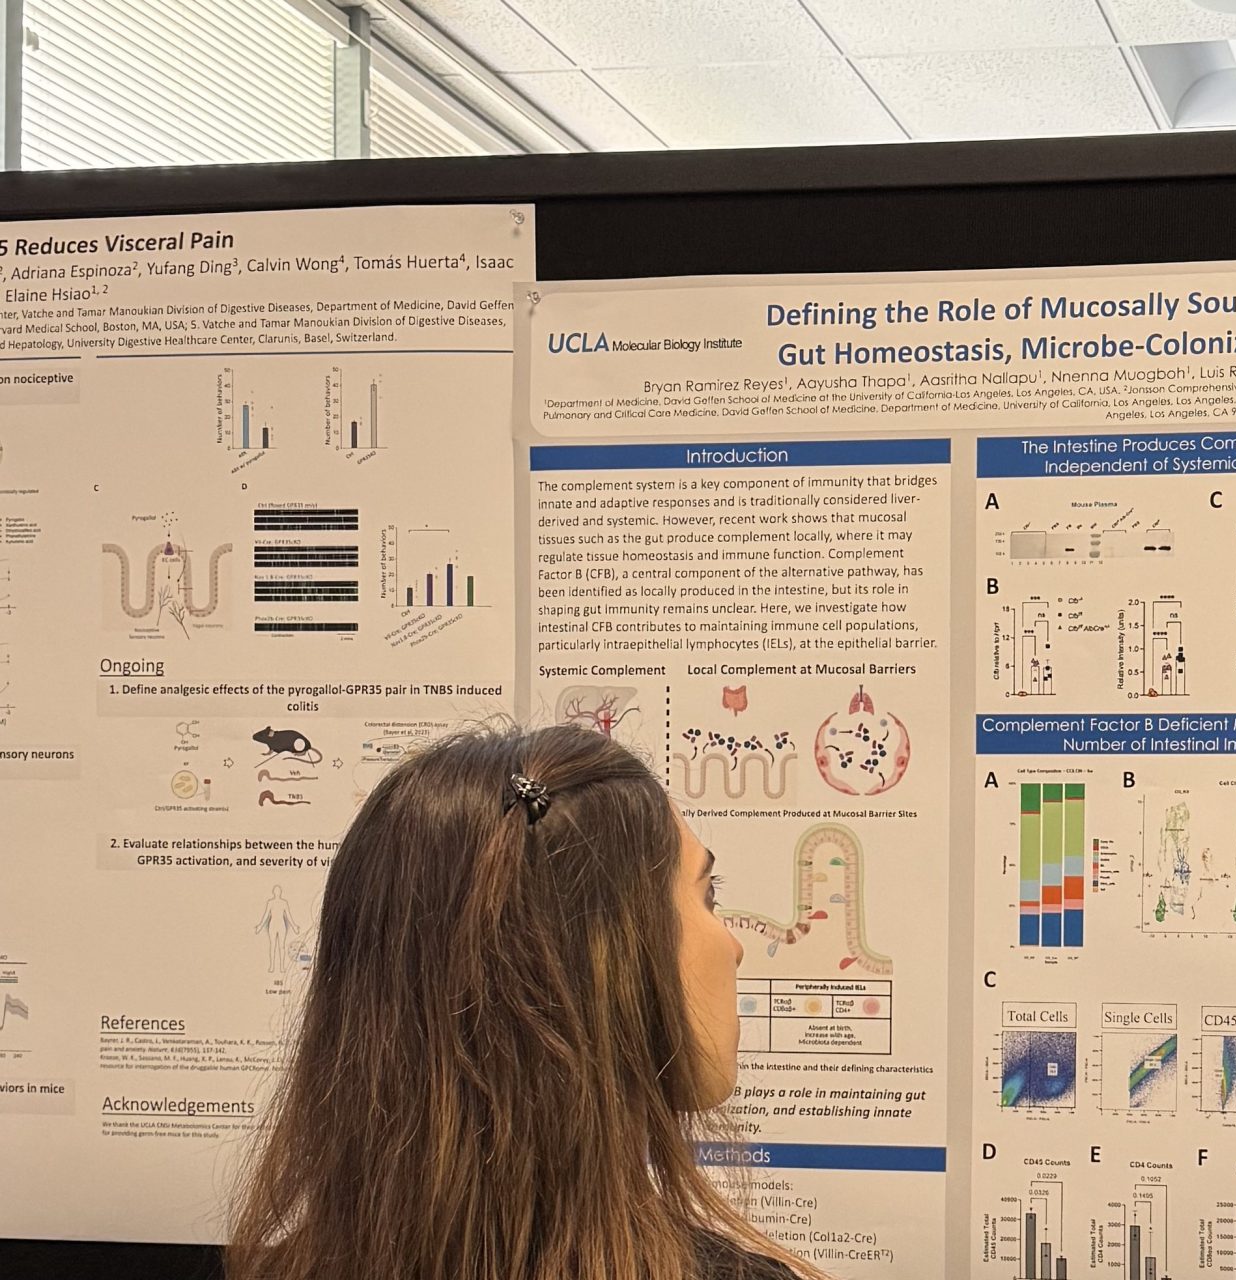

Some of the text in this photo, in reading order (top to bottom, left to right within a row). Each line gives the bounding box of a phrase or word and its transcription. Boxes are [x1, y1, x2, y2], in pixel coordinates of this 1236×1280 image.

[15, 230, 234, 256] Reduces Visceral Pain
[10, 265, 66, 280] Adriana
[246, 257, 293, 274] Calvin
[767, 301, 878, 330] Defining
[884, 299, 929, 324] the
[938, 297, 996, 322] Role
[1004, 296, 1034, 320] of
[1041, 291, 1180, 319] Mucosally
[548, 332, 743, 354] UCLA Molecular Biology Institute
[778, 343, 826, 367] Gut
[835, 337, 1012, 365] Homeostasis,
[13, 372, 74, 386] nociceptive
[644, 378, 739, 396] Bryan Ramirez
[1021, 440, 1049, 454] The
[1053, 438, 1118, 454] Intestine
[1122, 437, 1196, 452] Produces
[687, 447, 789, 464] Introduction
[1045, 457, 1148, 474] Independent
[1152, 456, 1169, 472] of
[537, 474, 938, 494] The complement system is a key component of immunity that bridges
[984, 492, 1000, 510] A
[1210, 491, 1223, 509] C
[987, 577, 999, 595] B
[99, 657, 165, 676] Ongoing
[539, 664, 666, 679] Systemic Complement
[687, 663, 916, 677] Local Complement at Mucosal Barriers
[109, 683, 502, 697] 1. Define analgesic effects of the pyrogallol-GPR35 pair in TNBS induced
[286, 701, 319, 712] colitis
[982, 717, 1085, 735] Complement
[1090, 717, 1141, 732] Factor
[1144, 717, 1154, 732] B
[1158, 717, 1229, 732] Deficient
[1063, 737, 1127, 752] Number
[1130, 737, 1147, 751] of
[1151, 736, 1219, 752] Intestinal
[32, 749, 75, 760] neurons
[984, 771, 999, 788] A
[110, 838, 315, 852] 2. Evaluate relationships between the
[983, 970, 997, 988] C
[100, 1014, 185, 1033] References
[1007, 1010, 1069, 1023] Total Cells
[1104, 1010, 1174, 1028] Single Cells
[27, 1082, 65, 1094] in mice
[743, 1085, 926, 1103] plays a role in maintaining gut
[102, 1097, 255, 1116] Acknowledgements
[982, 1143, 997, 1160] D
[760, 1195, 818, 1210] (Villin-Cre)
[809, 1230, 877, 1246] (Col1a2-Cre)
